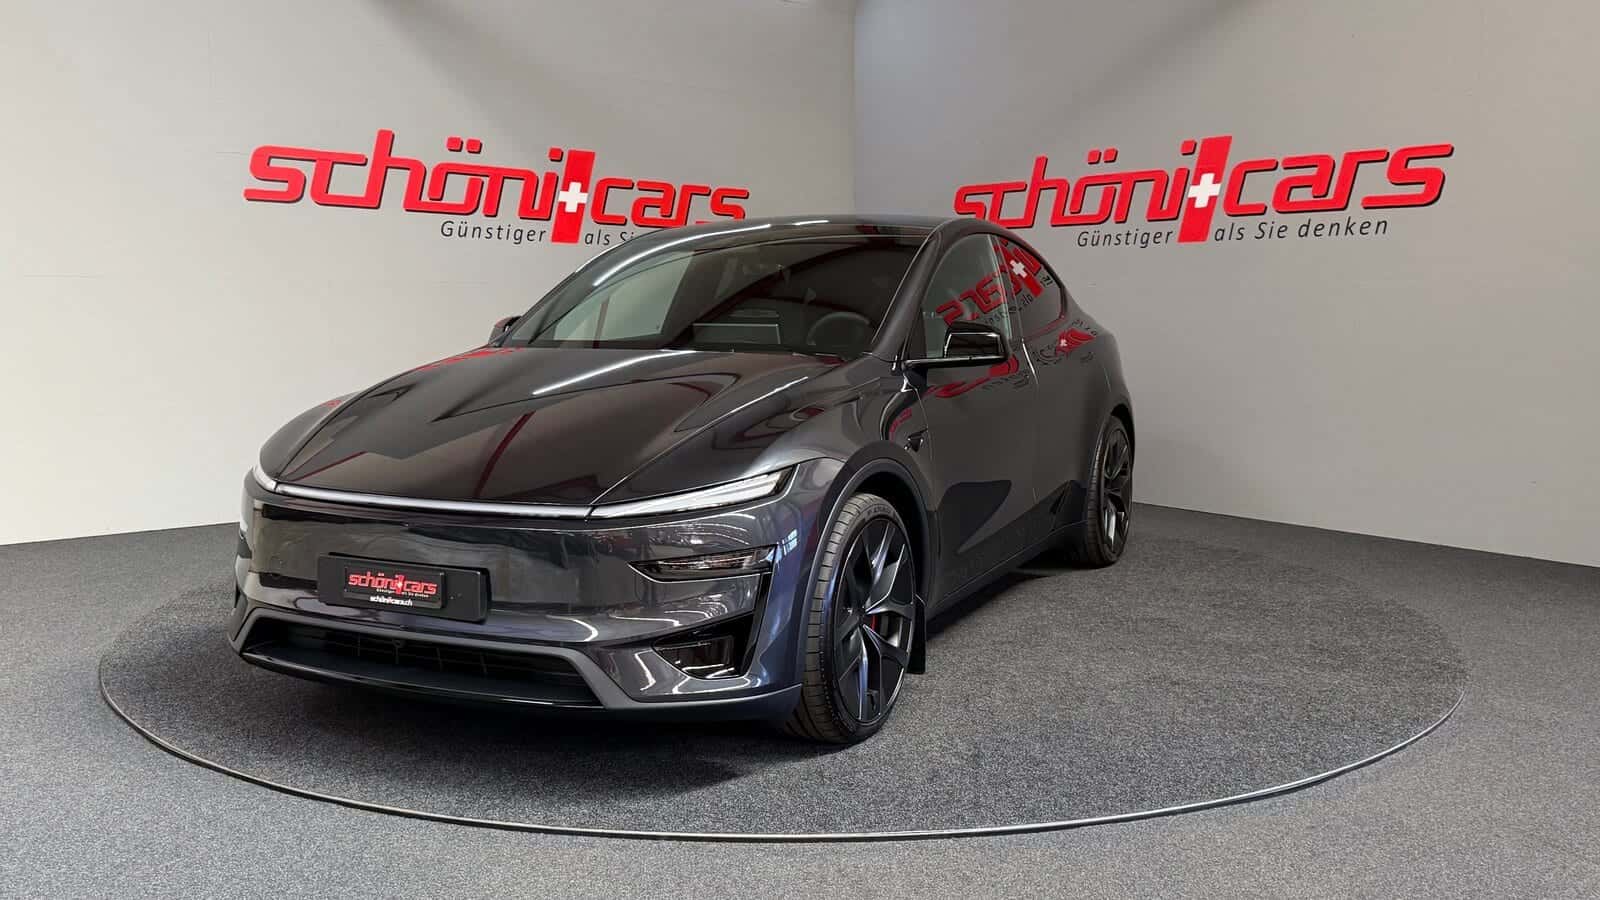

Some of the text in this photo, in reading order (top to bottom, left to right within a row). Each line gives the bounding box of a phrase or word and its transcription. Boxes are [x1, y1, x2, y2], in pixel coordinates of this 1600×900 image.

[440, 219, 547, 245] Günstiger
[584, 228, 611, 246] als
[1077, 217, 1389, 248] Günstiger als Sie denken
